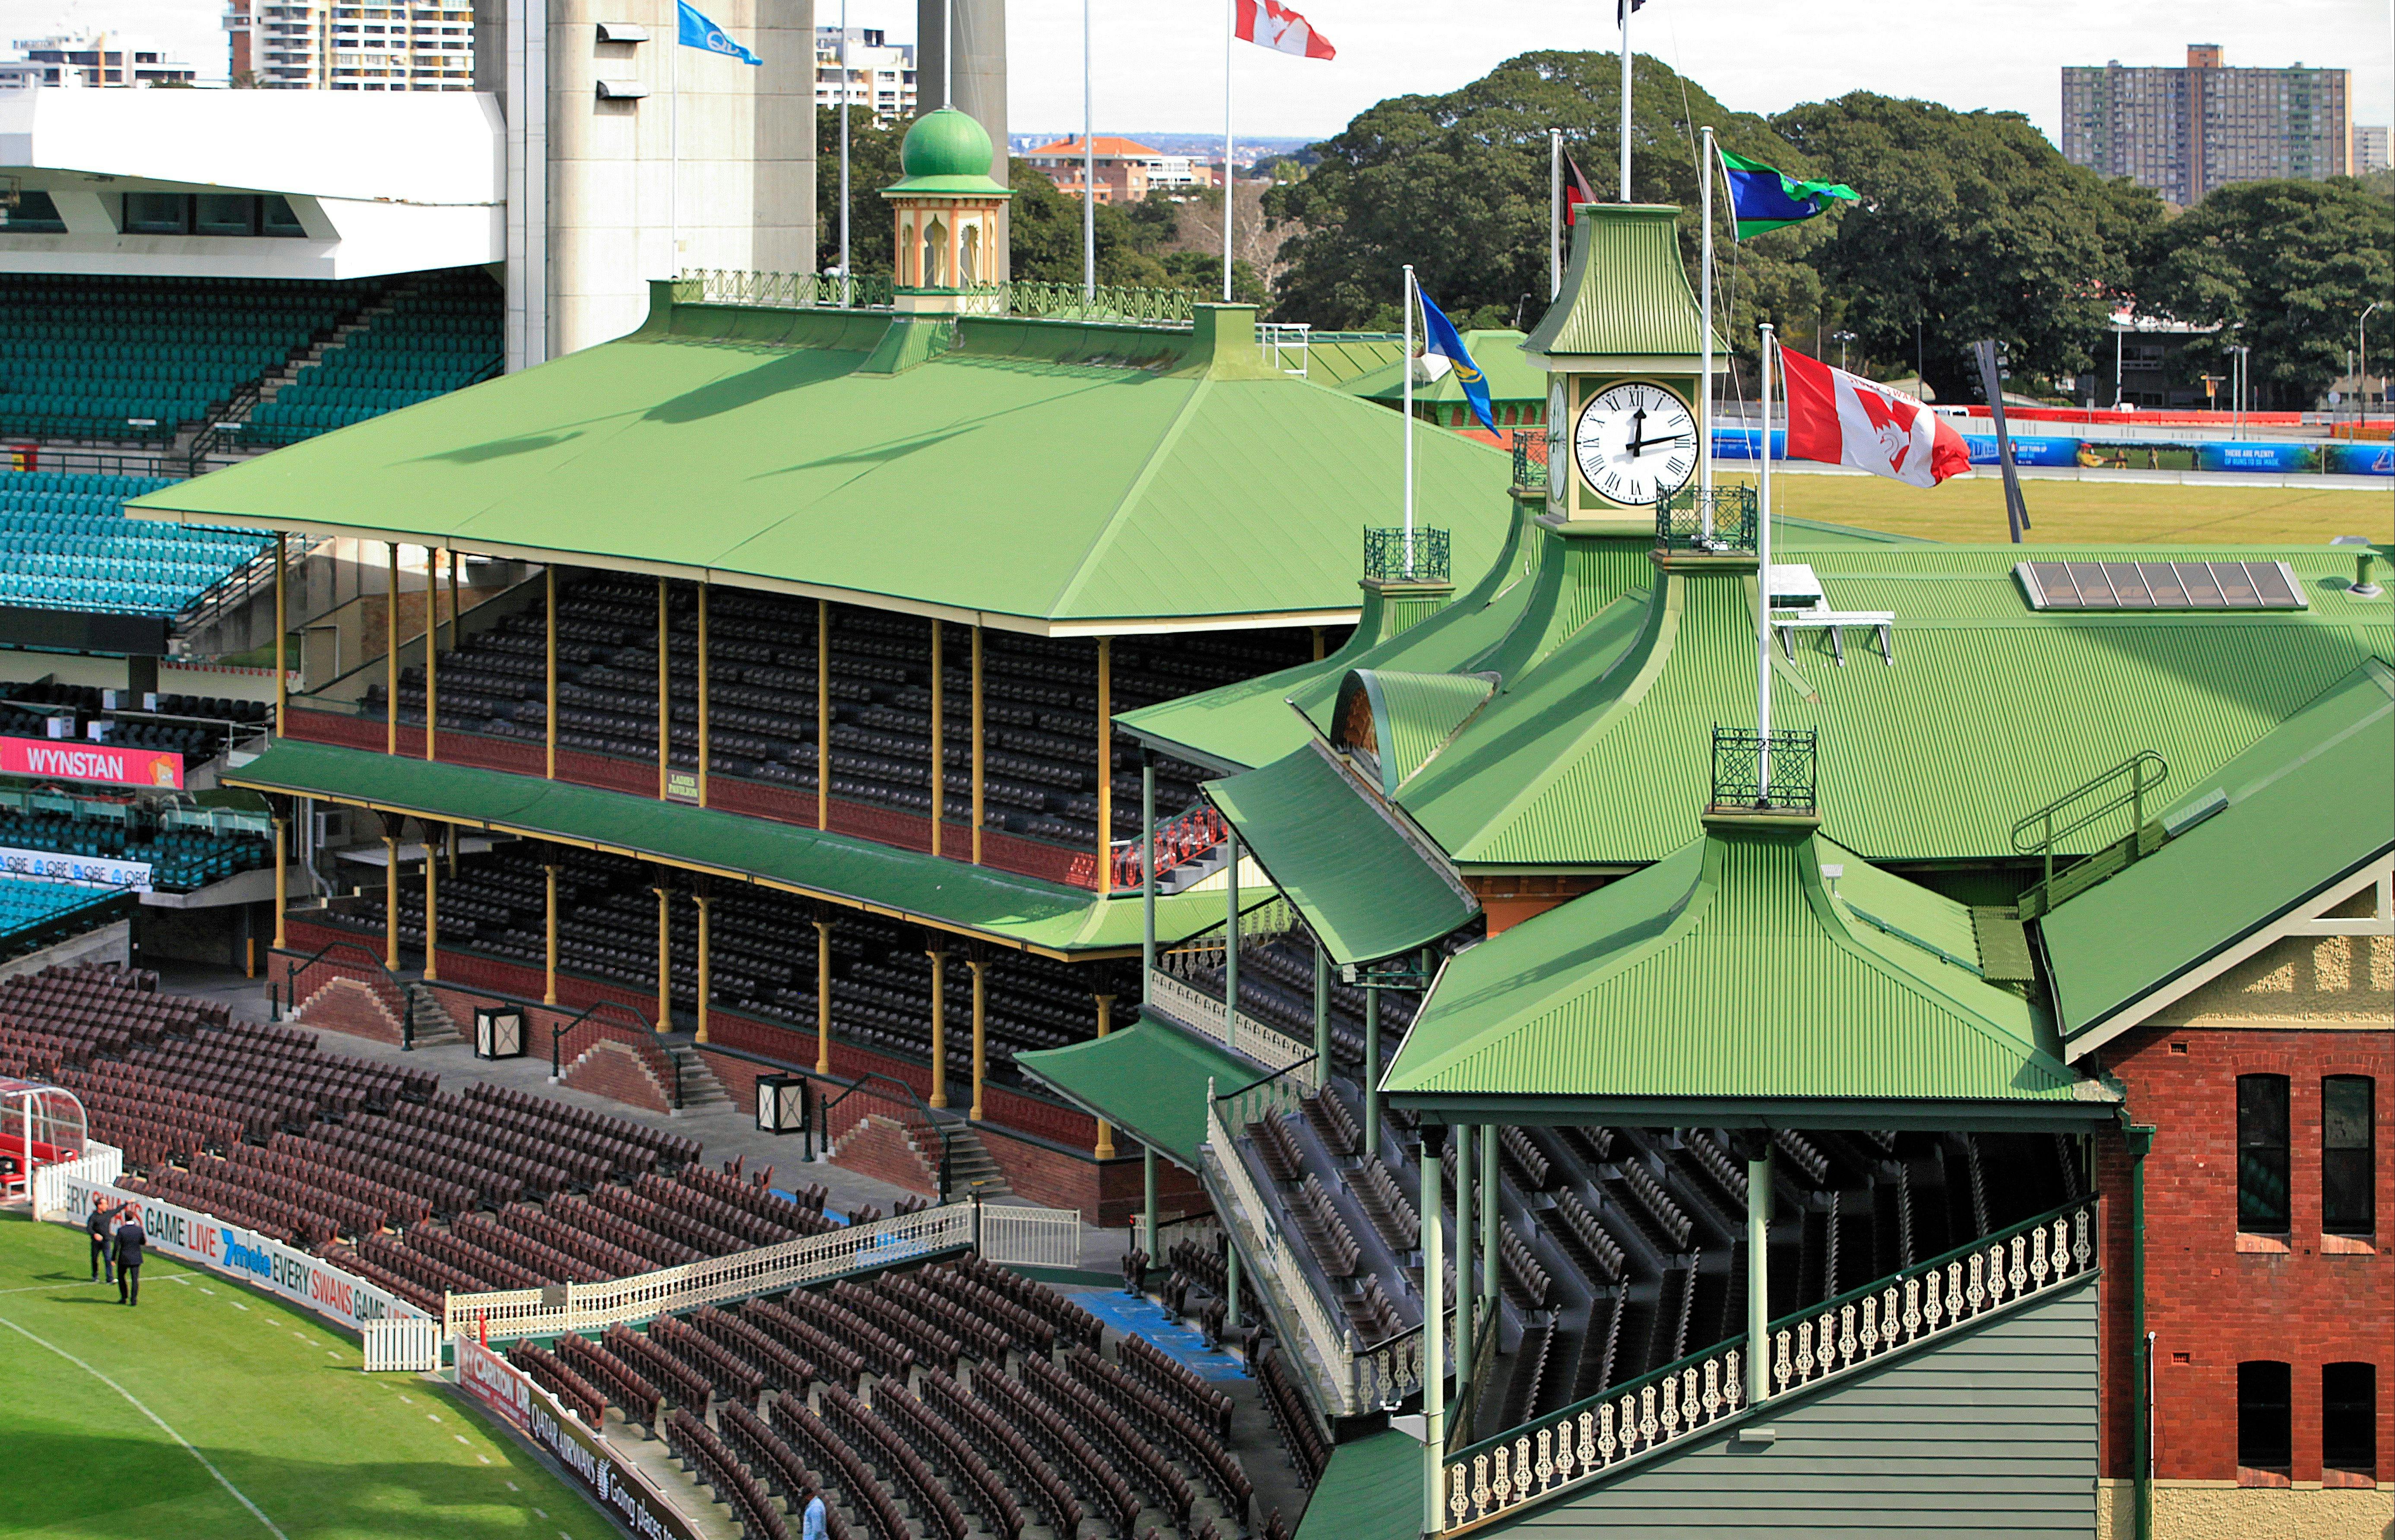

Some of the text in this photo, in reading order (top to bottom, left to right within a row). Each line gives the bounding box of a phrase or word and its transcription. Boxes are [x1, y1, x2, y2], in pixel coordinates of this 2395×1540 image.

[1605, 396, 1621, 414] XI
[1629, 390, 1644, 407] XII
[1654, 397, 1663, 411] I
[1589, 414, 1605, 428] X
[1668, 414, 1684, 428] II
[2224, 449, 2241, 457] THERE
[27, 747, 124, 780] WYNSTAN
[7, 856, 148, 886] QBE QBE QBE QBE
[145, 1207, 186, 1246] GAME
[188, 1220, 217, 1258] LIVE
[273, 1252, 310, 1295] EVERY
[311, 1268, 353, 1315] SWANS
[354, 1290, 386, 1321] GAME
[475, 1352, 515, 1403] CARLTON
[531, 1403, 558, 1451] QATAR
[558, 1430, 596, 1485] AIRWAYS
[610, 1472, 636, 1527] Going
[637, 1498, 662, 1540] places
